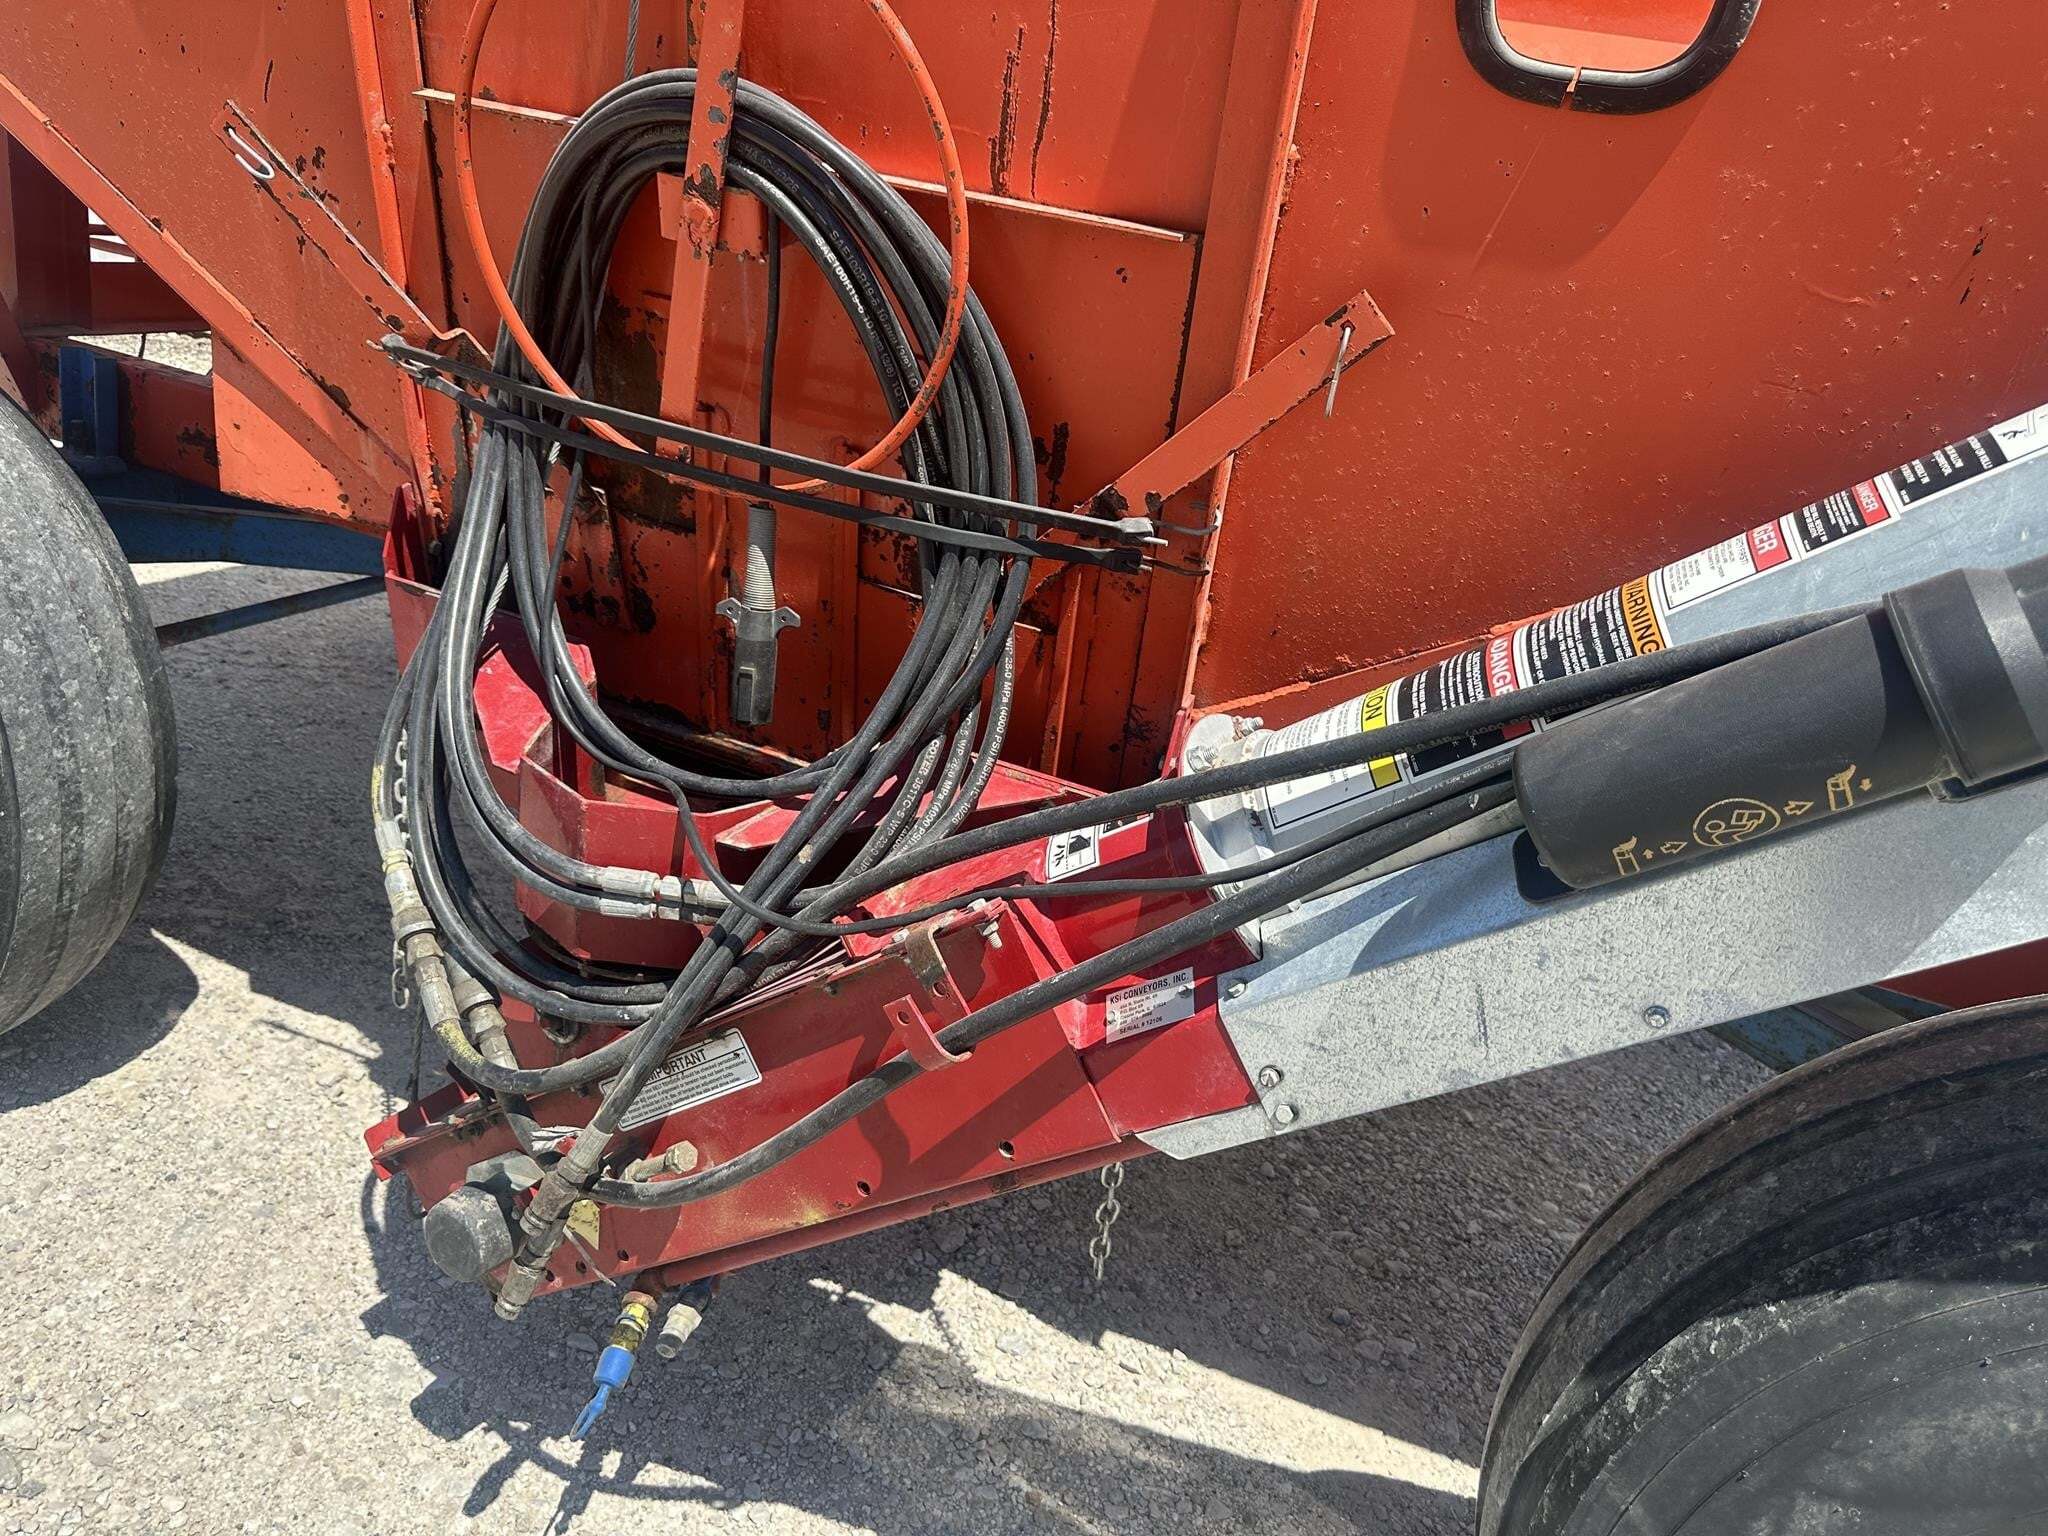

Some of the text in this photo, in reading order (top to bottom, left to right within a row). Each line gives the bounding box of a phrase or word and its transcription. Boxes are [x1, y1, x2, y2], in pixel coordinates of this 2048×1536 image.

[1751, 522, 1779, 555] GER
[1569, 648, 1580, 673] PERFOR
[1593, 637, 1606, 666] HYDRAUL
[1490, 642, 1512, 696] DANGE
[1000, 680, 1012, 704] MPa
[994, 705, 1008, 733] (4000
[1123, 978, 1170, 999] CONVEYORS,
[1173, 972, 1189, 983] INC.
[1119, 1024, 1140, 1034] SERIAL
